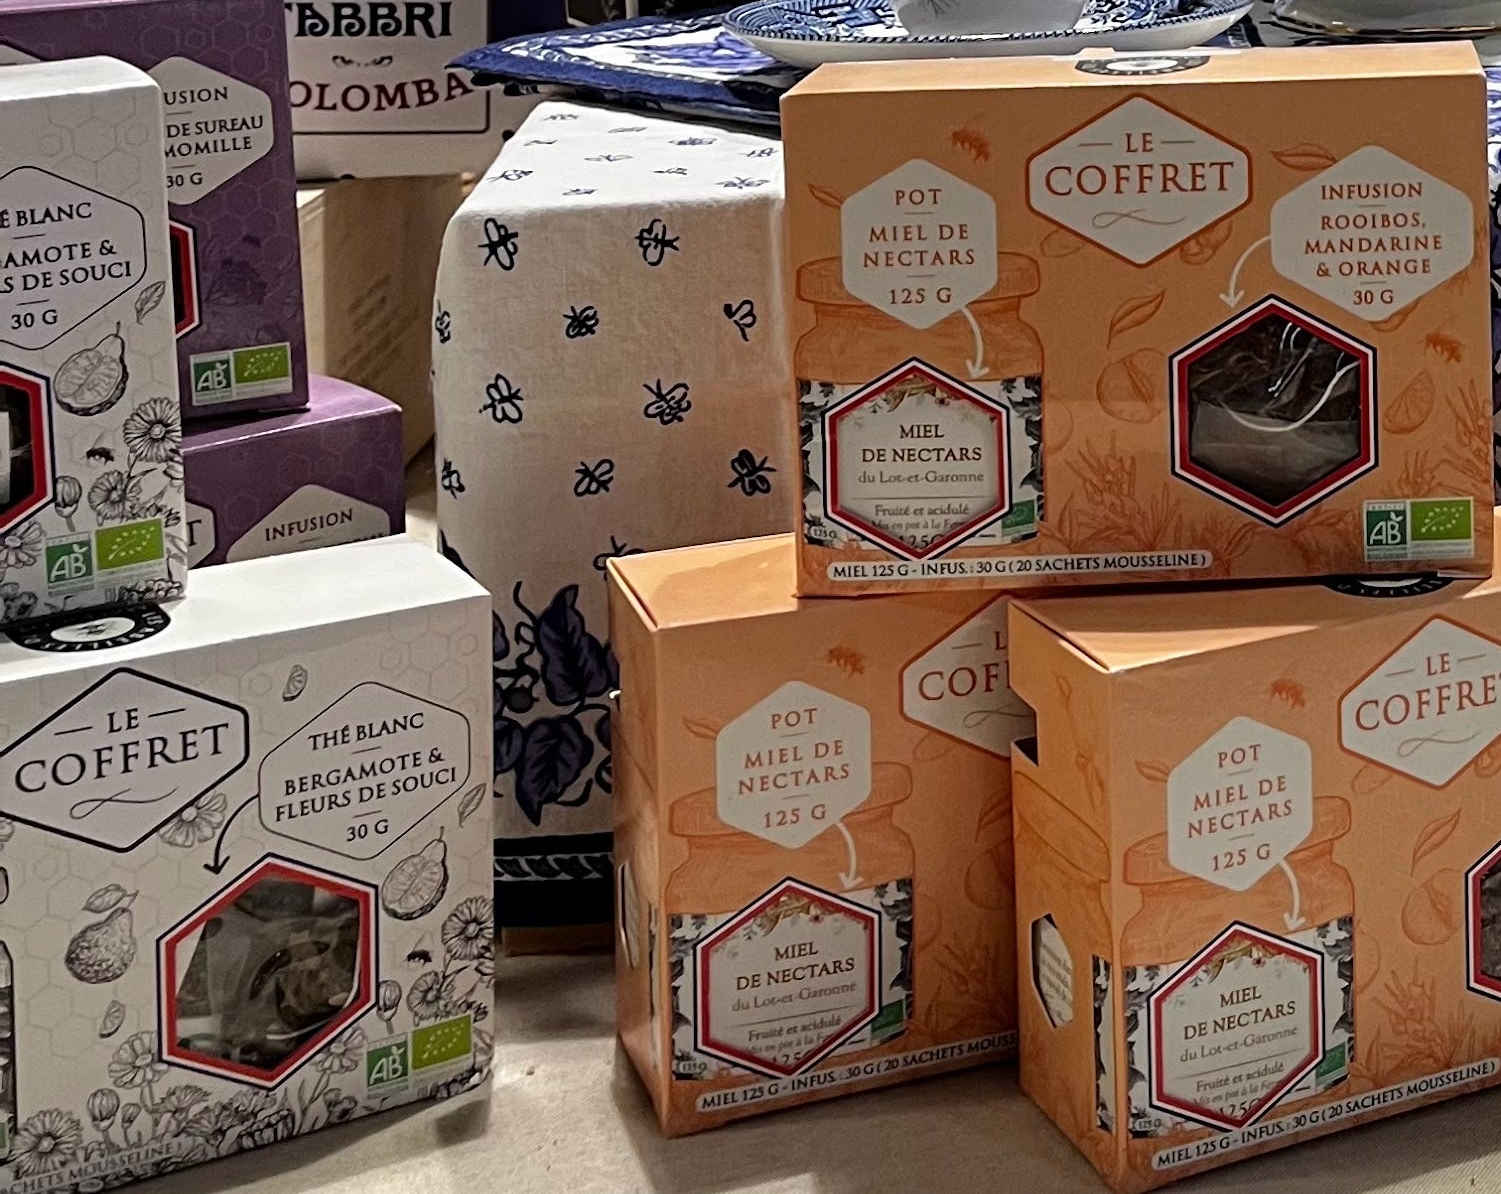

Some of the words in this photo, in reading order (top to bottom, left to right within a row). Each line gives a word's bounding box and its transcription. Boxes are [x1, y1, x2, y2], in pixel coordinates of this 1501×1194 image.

[284, 0, 453, 39] ABBRI
[163, 87, 229, 106] USION
[289, 71, 475, 113] OLOMBA
[166, 123, 192, 139] DE
[195, 115, 264, 136] SUREAU
[164, 135, 253, 158] MOMILLE
[1124, 132, 1154, 154] LE
[167, 174, 185, 189] 30
[189, 172, 204, 186] G
[1044, 161, 1235, 197] COFFRET
[894, 188, 943, 207] POT
[1320, 181, 1424, 202] INFUSION
[16, 202, 93, 227] BLANC
[1320, 211, 1427, 231] ROOIBOS,
[869, 224, 929, 244] MIEL
[938, 223, 970, 241] DE
[1304, 234, 1443, 256] MANDARINE
[0, 242, 93, 270] AMOTE
[99, 239, 118, 257] &
[863, 248, 976, 269] NECTARS
[22, 271, 54, 292] DE
[59, 261, 133, 287] SOUCI
[1316, 262, 1333, 278] &
[1338, 258, 1432, 278] ORANGE
[889, 287, 927, 306] 125
[936, 286, 953, 305] G
[1352, 290, 1375, 306] 30
[1380, 289, 1395, 305] G
[11, 312, 35, 331] 30
[42, 309, 59, 326] G
[197, 367, 228, 393] AB
[900, 424, 946, 440] MIEL
[861, 447, 887, 464] DE
[892, 447, 983, 464] NECTARS
[858, 470, 877, 485] du
[264, 507, 354, 543] INFUSION
[1369, 520, 1402, 546] AB
[833, 564, 868, 579] MIEL
[872, 563, 895, 578] 125
[897, 563, 910, 577] G
[977, 561, 993, 575] 30
[994, 560, 1007, 574] G
[1035, 557, 1101, 573] SACHETS
[1103, 553, 1199, 570] MOUSSELINE
[1425, 652, 1452, 678] LE
[107, 707, 141, 734] LE
[307, 724, 351, 752] THÉ
[354, 712, 425, 743] BLANC
[15, 722, 230, 794] COFFRET
[284, 752, 423, 798] BERGAMOTE
[428, 747, 446, 764] &
[275, 790, 352, 823] FLEURS
[358, 782, 387, 805] DE
[391, 766, 458, 796] SOUCI
[346, 823, 369, 843] 30
[374, 818, 390, 835] G
